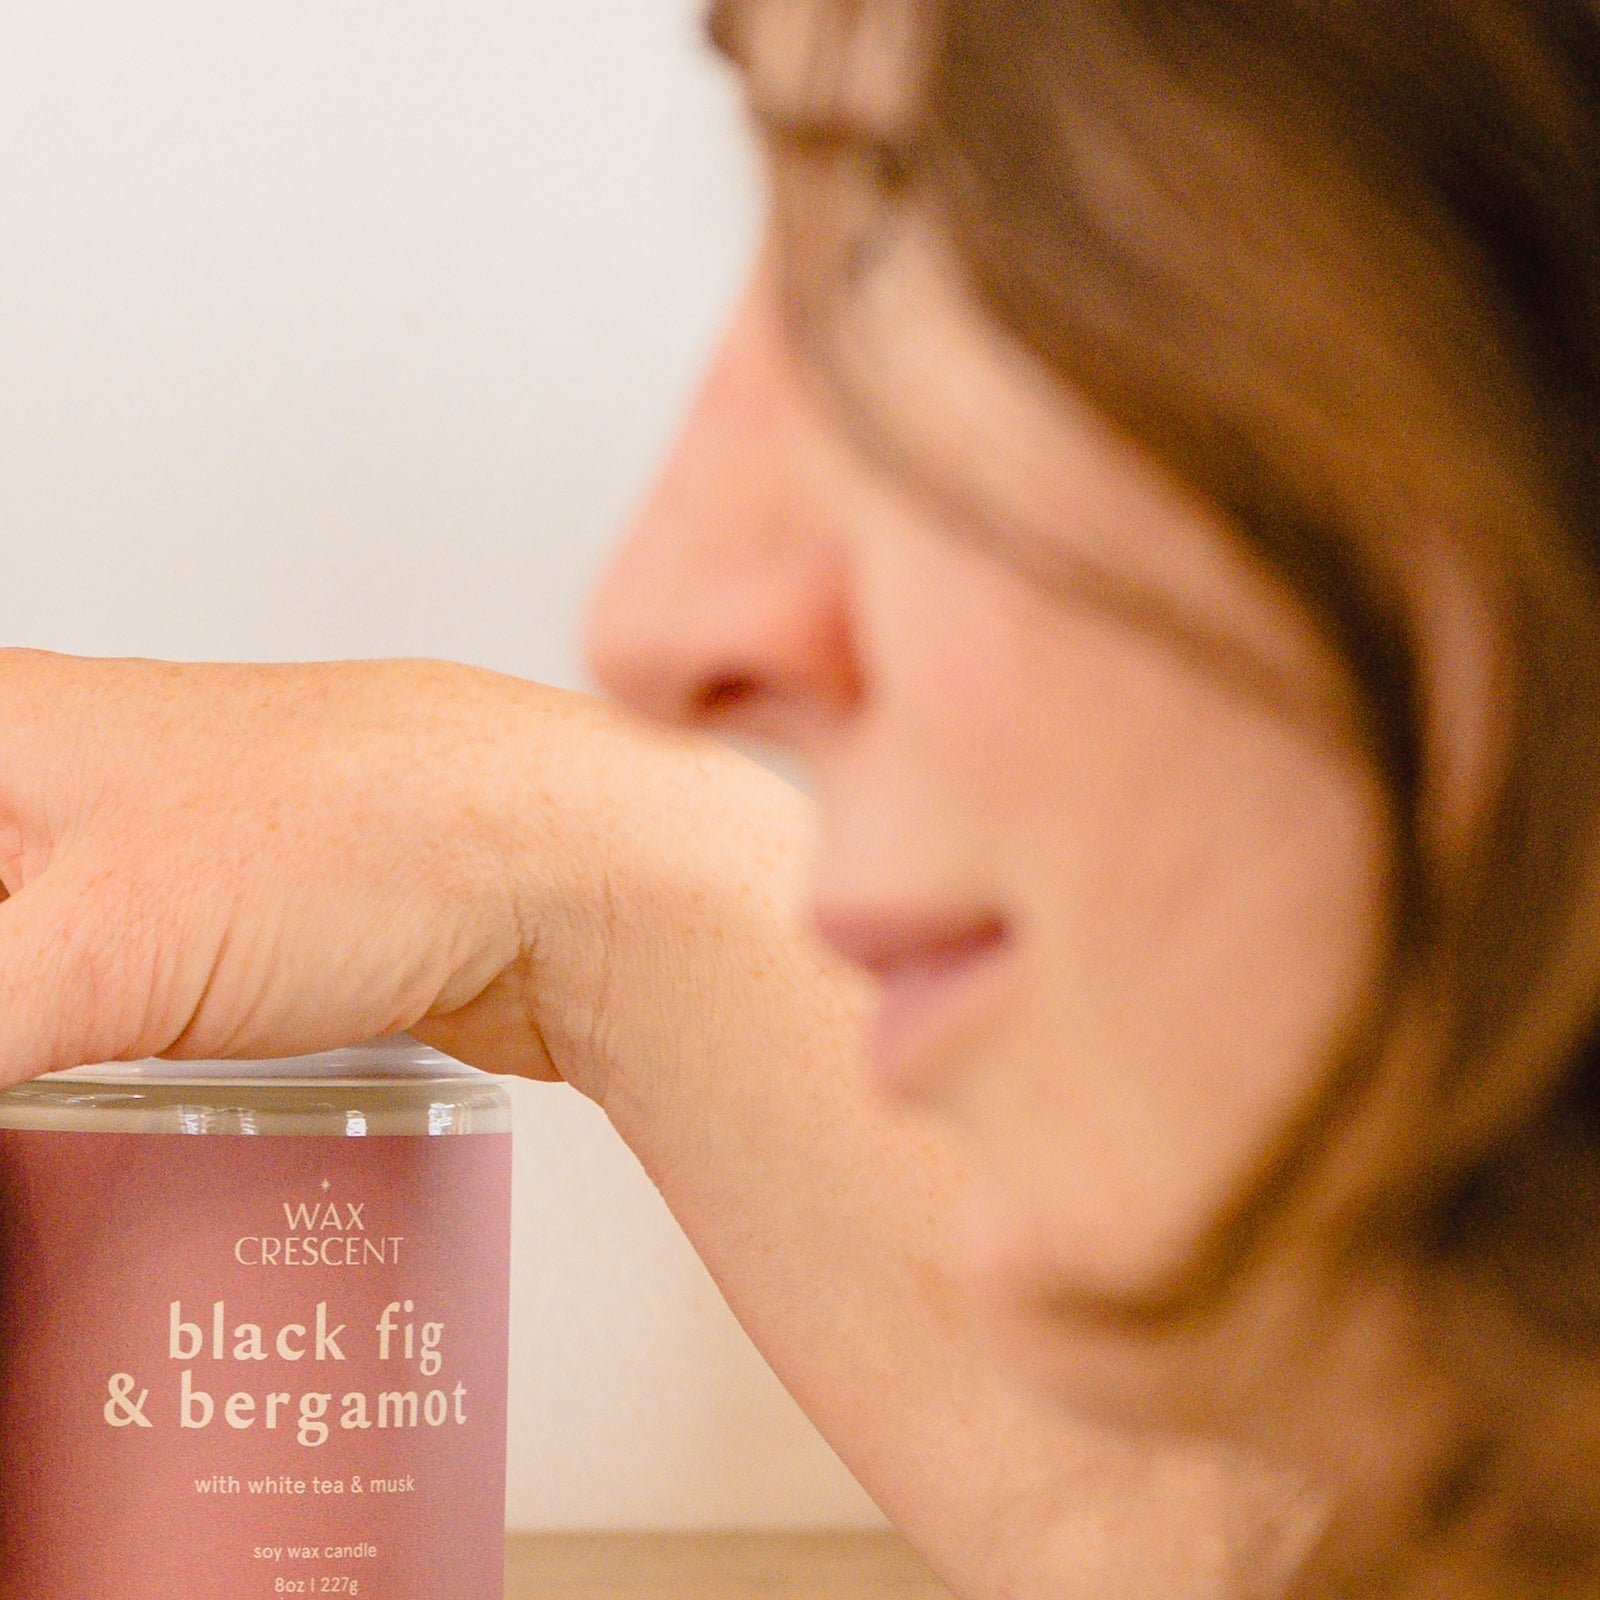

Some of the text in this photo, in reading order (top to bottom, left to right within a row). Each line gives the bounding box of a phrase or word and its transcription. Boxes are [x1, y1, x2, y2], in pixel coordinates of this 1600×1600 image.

[283, 1202, 365, 1231] WAX
[234, 1236, 402, 1266] CRESCENT
[169, 1299, 445, 1377] black fig
[104, 1369, 467, 1447] & bergamot
[194, 1474, 415, 1495] with white tea & musk
[253, 1542, 378, 1562] soy wax candle
[274, 1576, 305, 1593] 8oz
[320, 1575, 358, 1596] 227g
